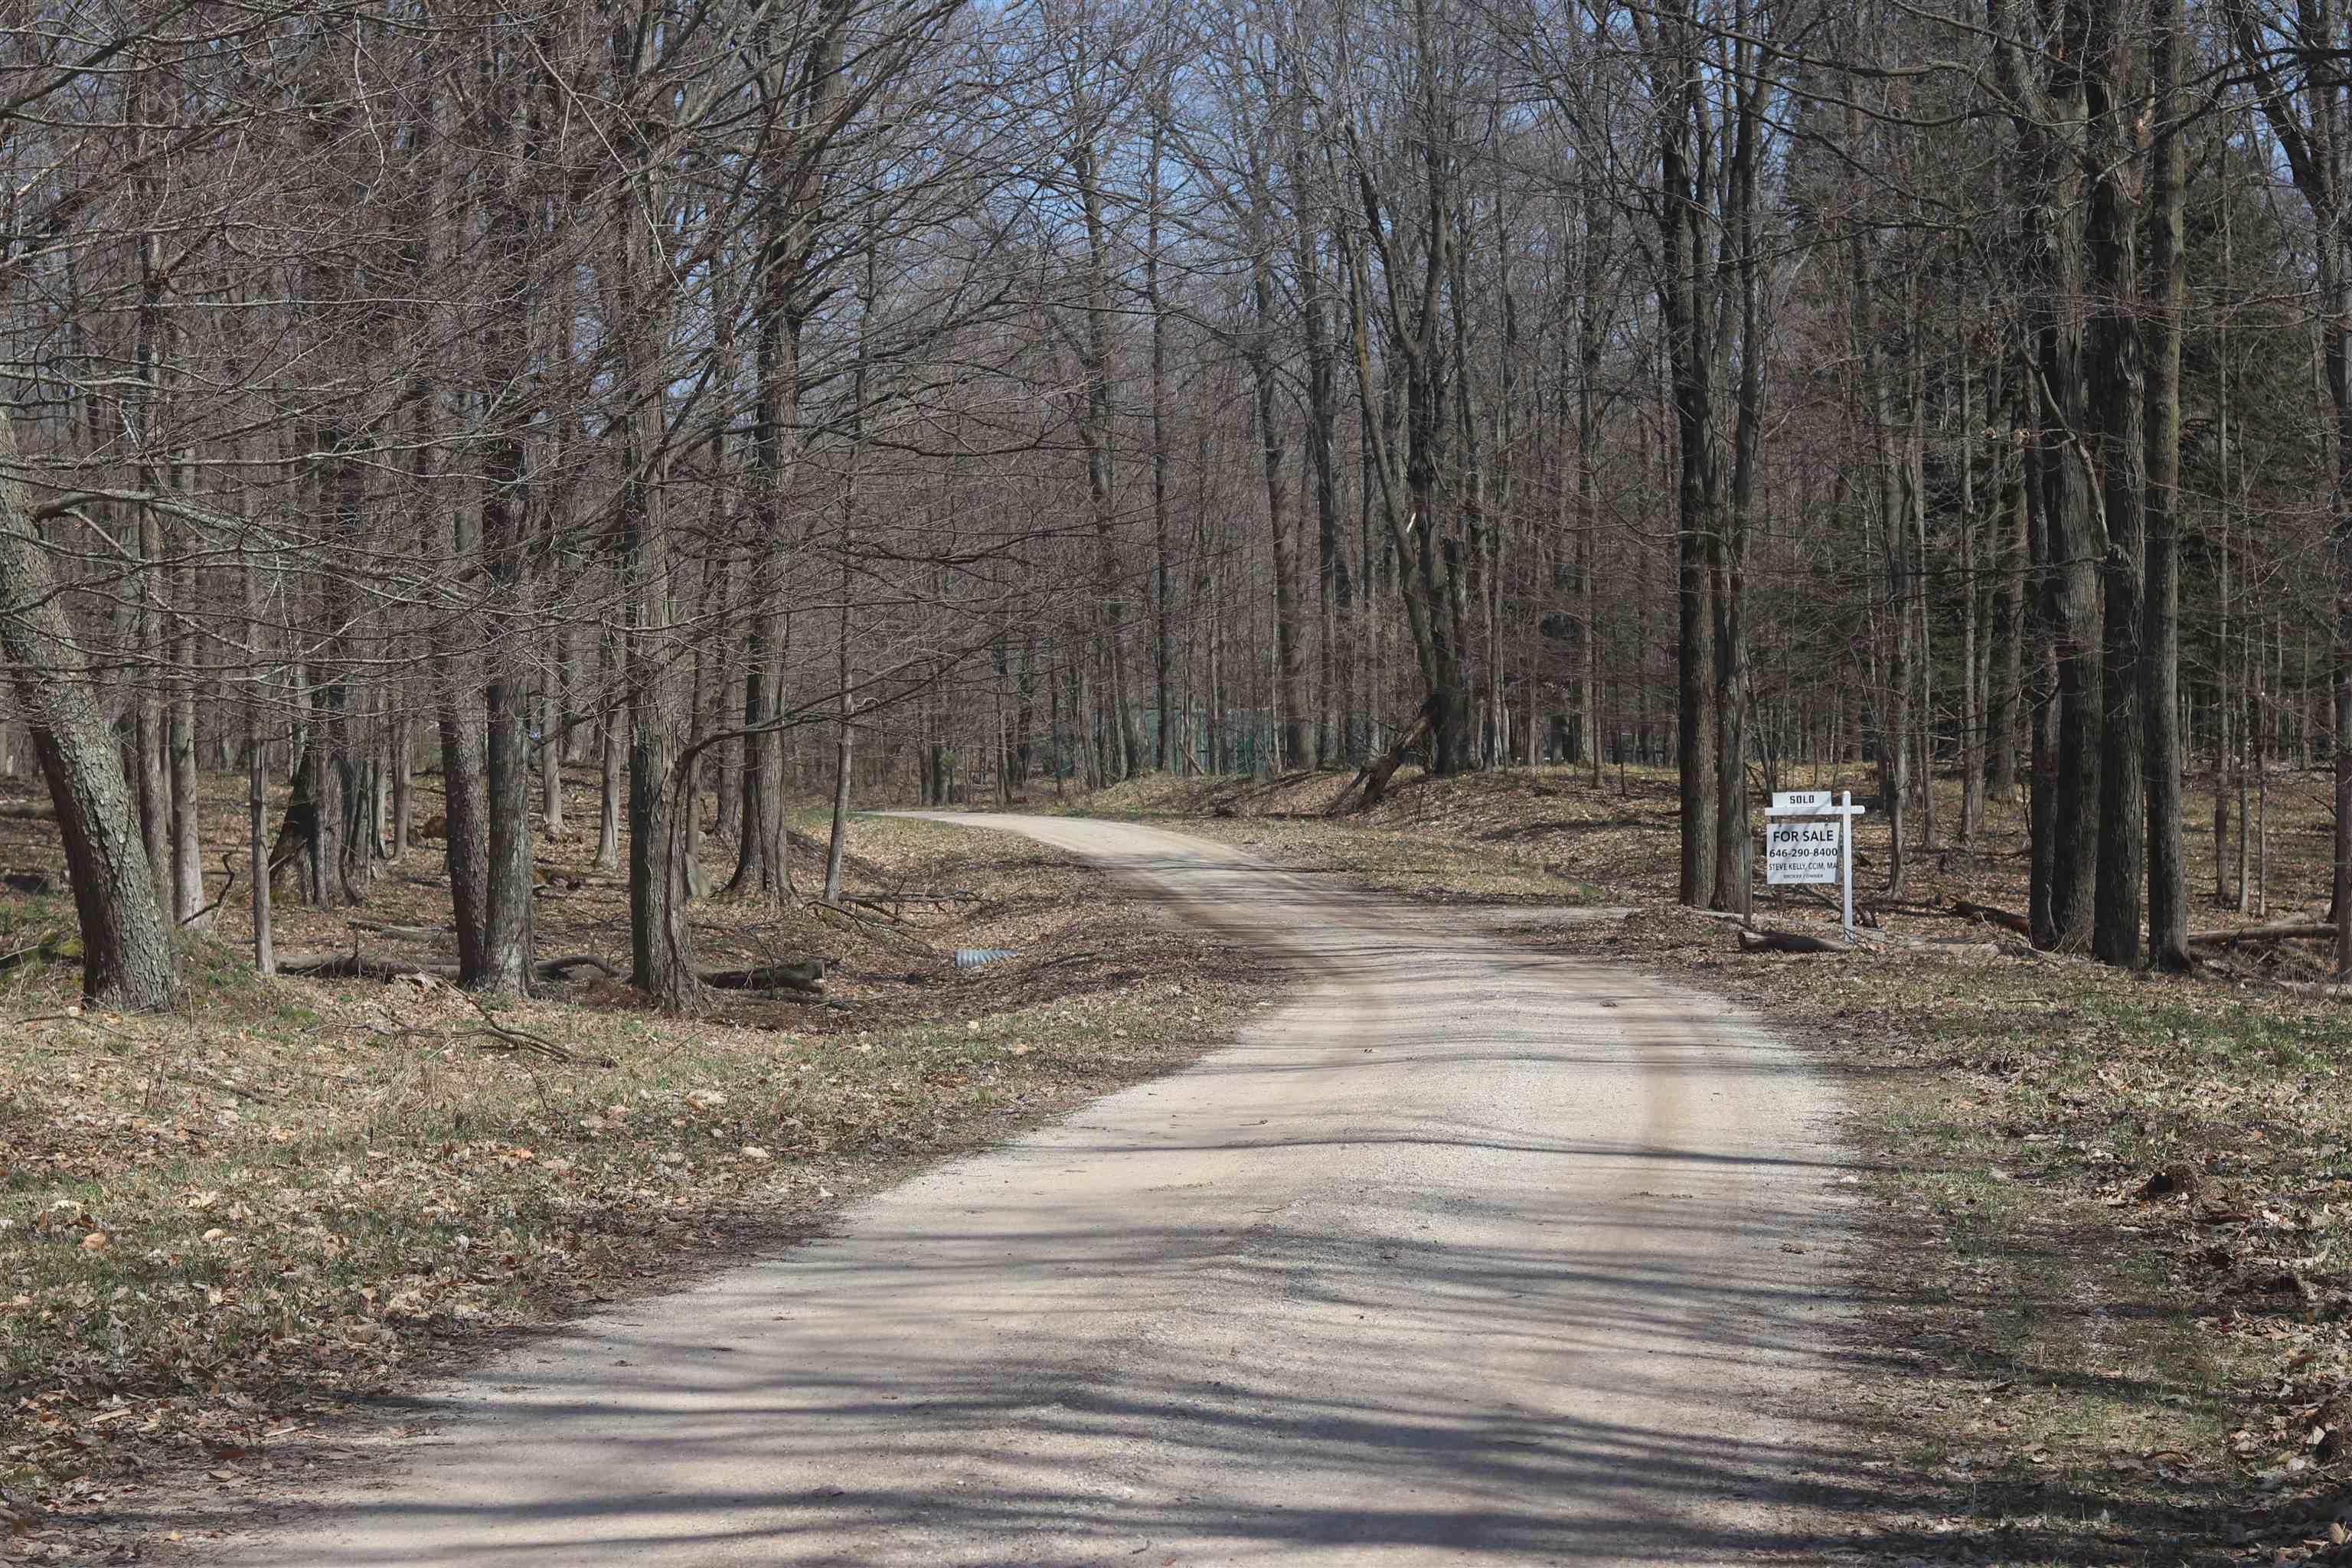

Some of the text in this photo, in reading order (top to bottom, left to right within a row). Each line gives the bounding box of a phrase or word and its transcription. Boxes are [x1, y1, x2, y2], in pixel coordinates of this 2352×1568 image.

[1790, 795, 1815, 804] SOLD
[1773, 831, 1833, 842] FOR SALE
[1769, 848, 1838, 858] 646-290-8400
